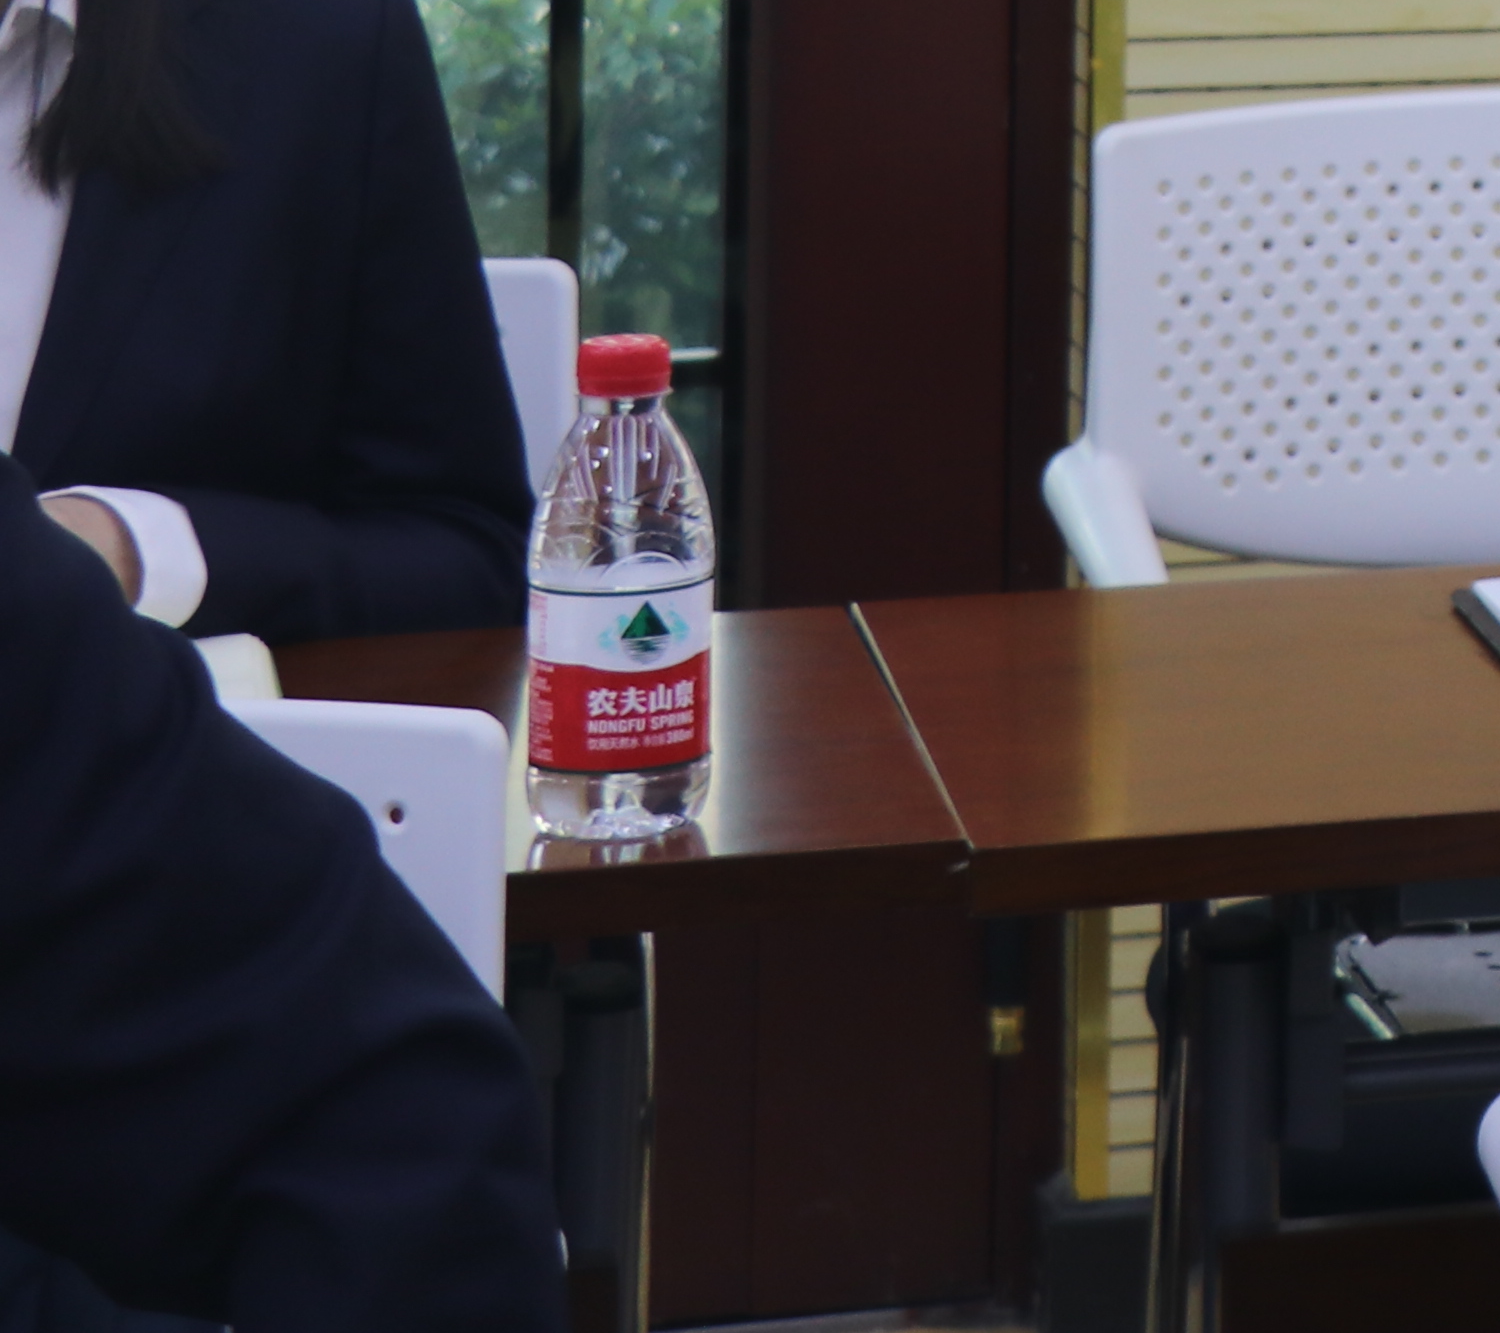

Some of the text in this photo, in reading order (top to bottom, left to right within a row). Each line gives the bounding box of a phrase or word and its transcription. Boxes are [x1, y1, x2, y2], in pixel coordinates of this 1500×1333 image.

[587, 678, 695, 718] 农夫山泉
[587, 718, 647, 734] NONGFU
